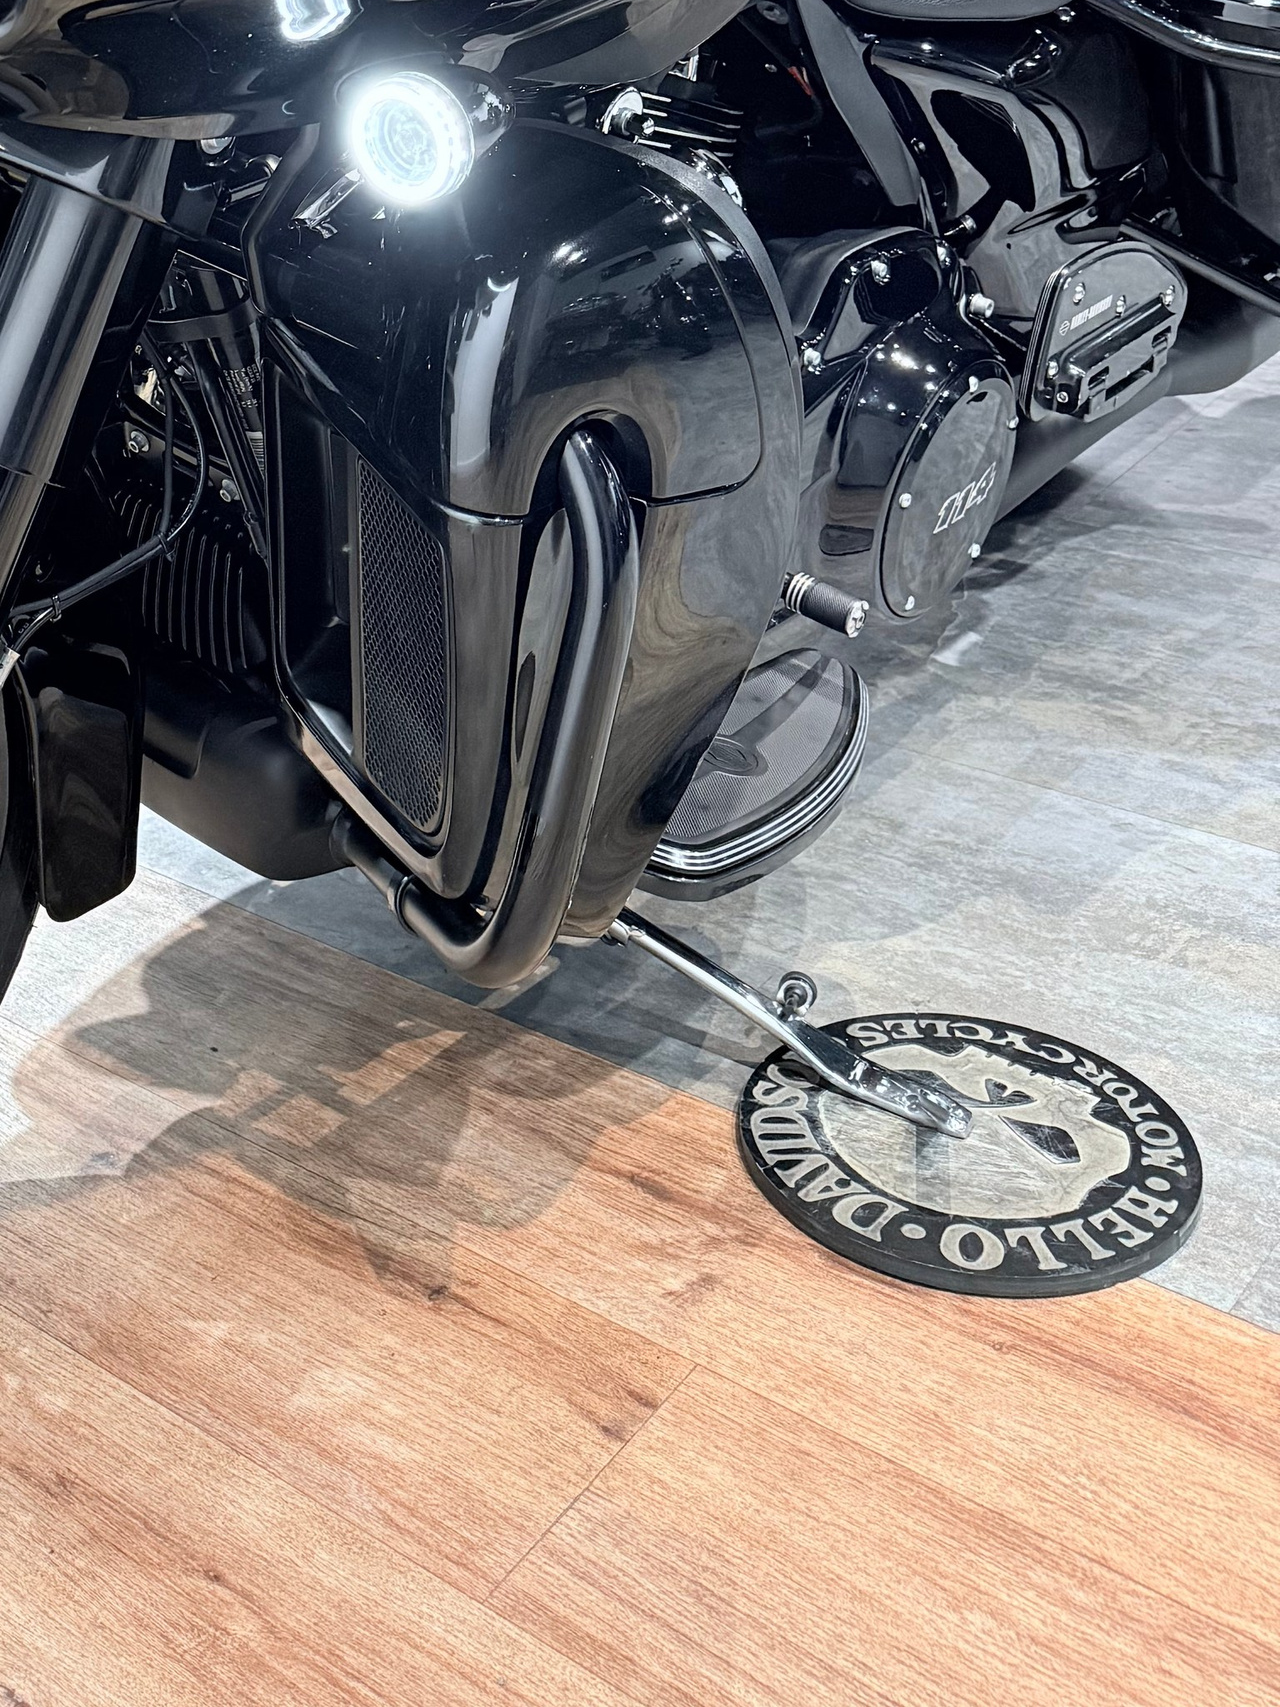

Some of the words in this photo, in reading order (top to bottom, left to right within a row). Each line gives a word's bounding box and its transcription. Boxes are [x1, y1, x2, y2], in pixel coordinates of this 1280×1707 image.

[750, 1051, 910, 1243] DAVIDSO
[845, 1019, 1188, 1179] MOTORCYCLES
[939, 1186, 1179, 1271] HELLO
